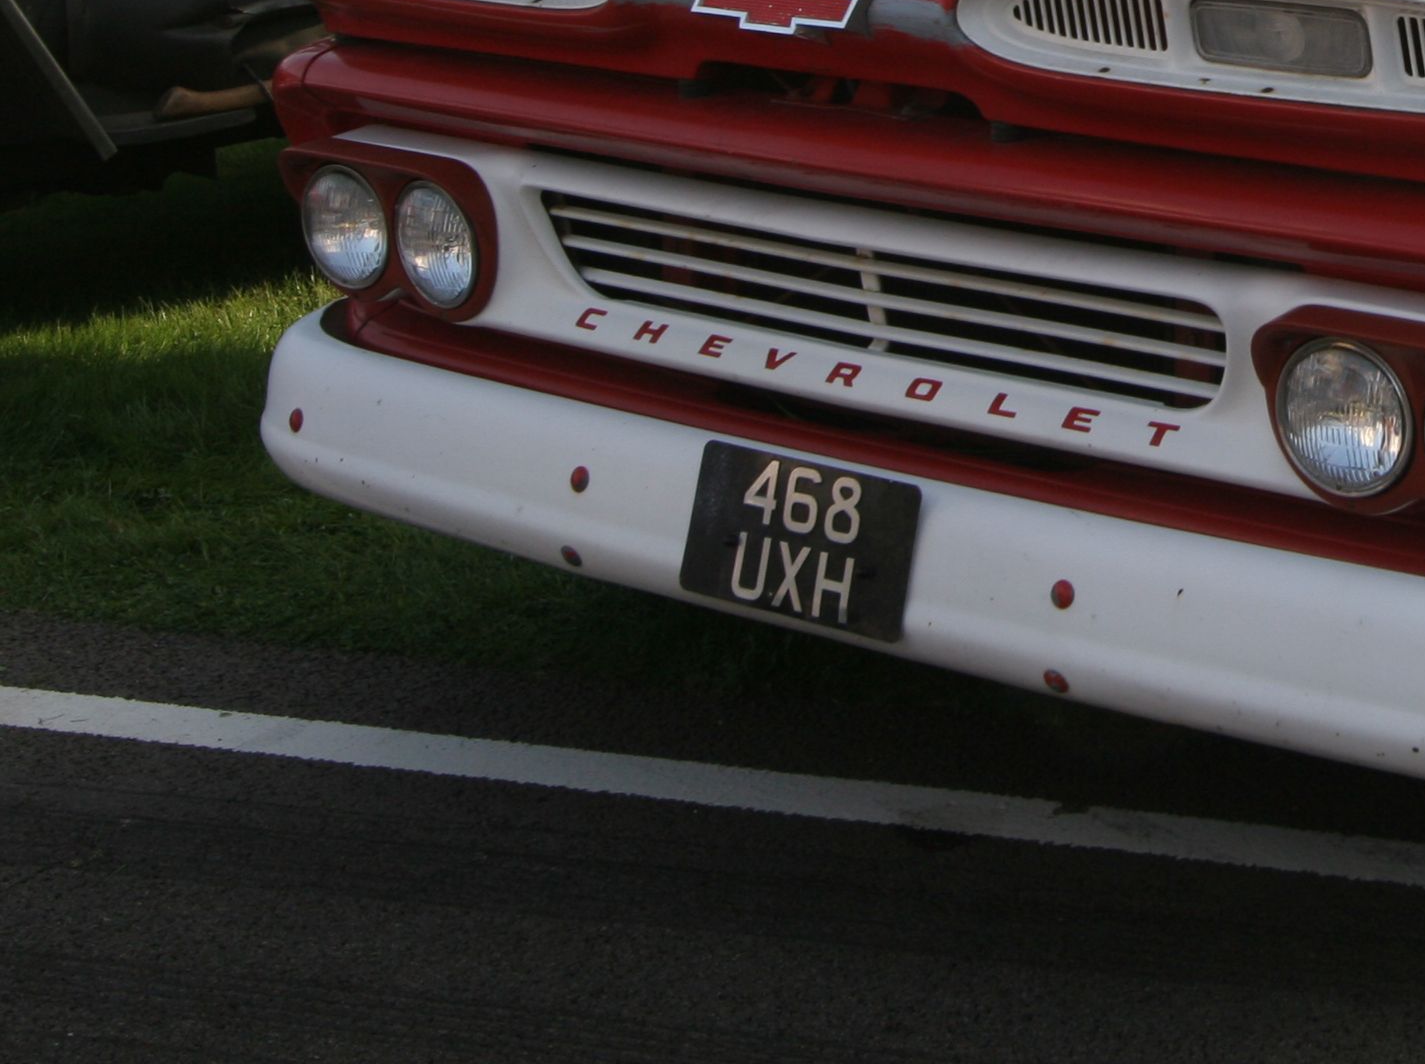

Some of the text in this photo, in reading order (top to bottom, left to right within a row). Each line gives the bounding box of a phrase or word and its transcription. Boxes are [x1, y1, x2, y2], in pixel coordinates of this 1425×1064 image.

[575, 307, 1181, 447] CHEVROLET
[743, 460, 862, 544] 468
[731, 531, 855, 624] UXH
